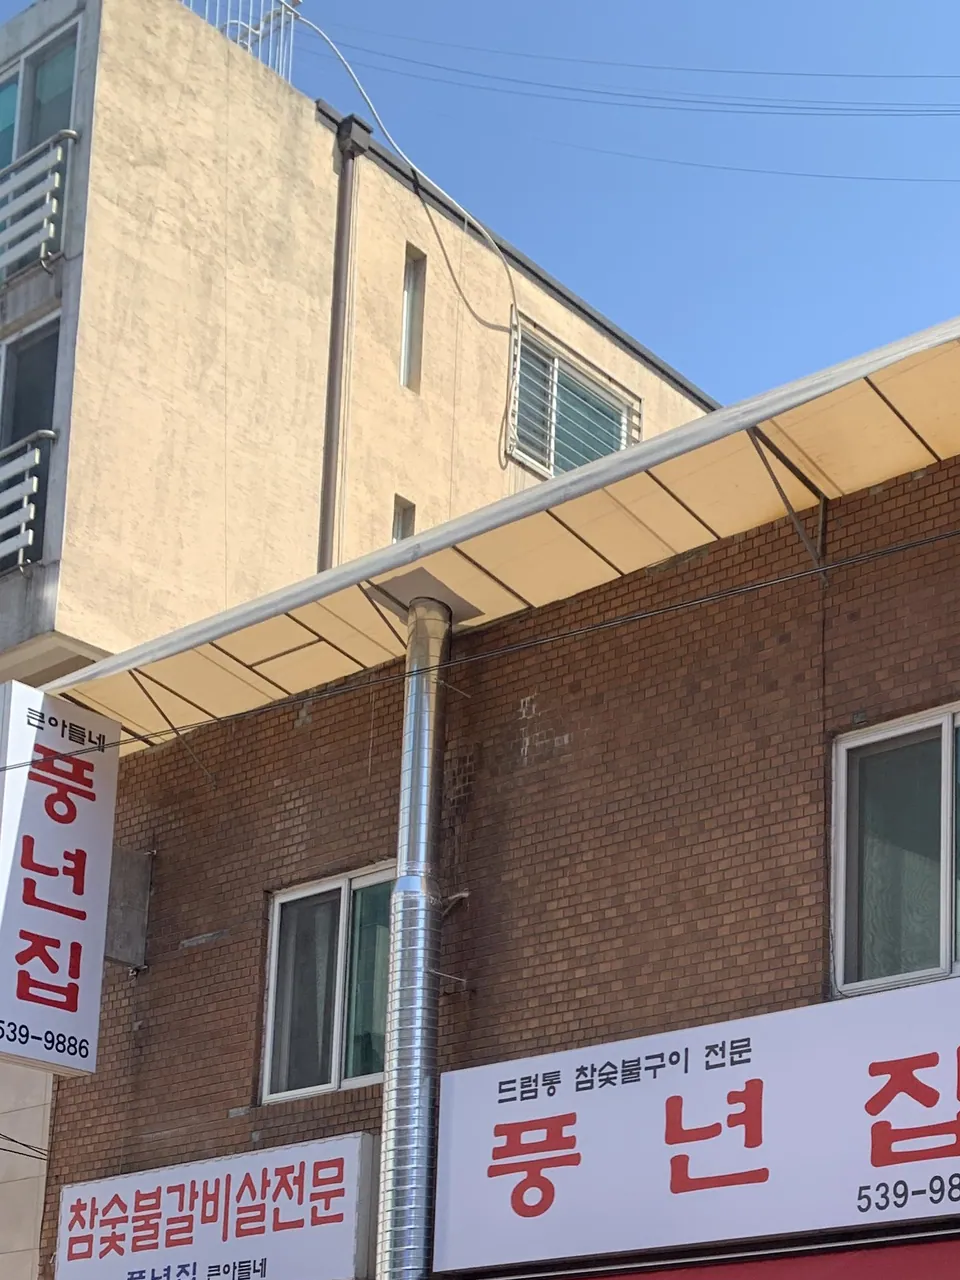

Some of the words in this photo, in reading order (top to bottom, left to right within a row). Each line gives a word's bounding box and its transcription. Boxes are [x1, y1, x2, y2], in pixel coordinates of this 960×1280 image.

[26, 707, 106, 753] 큰아들네
[15, 743, 97, 1013] 풍년집
[497, 1069, 561, 1104] 드럼통
[575, 1047, 690, 1093] 참숯불구이
[704, 1037, 752, 1071] 전문
[66, 1157, 345, 1261] 참숯불갈비살전문
